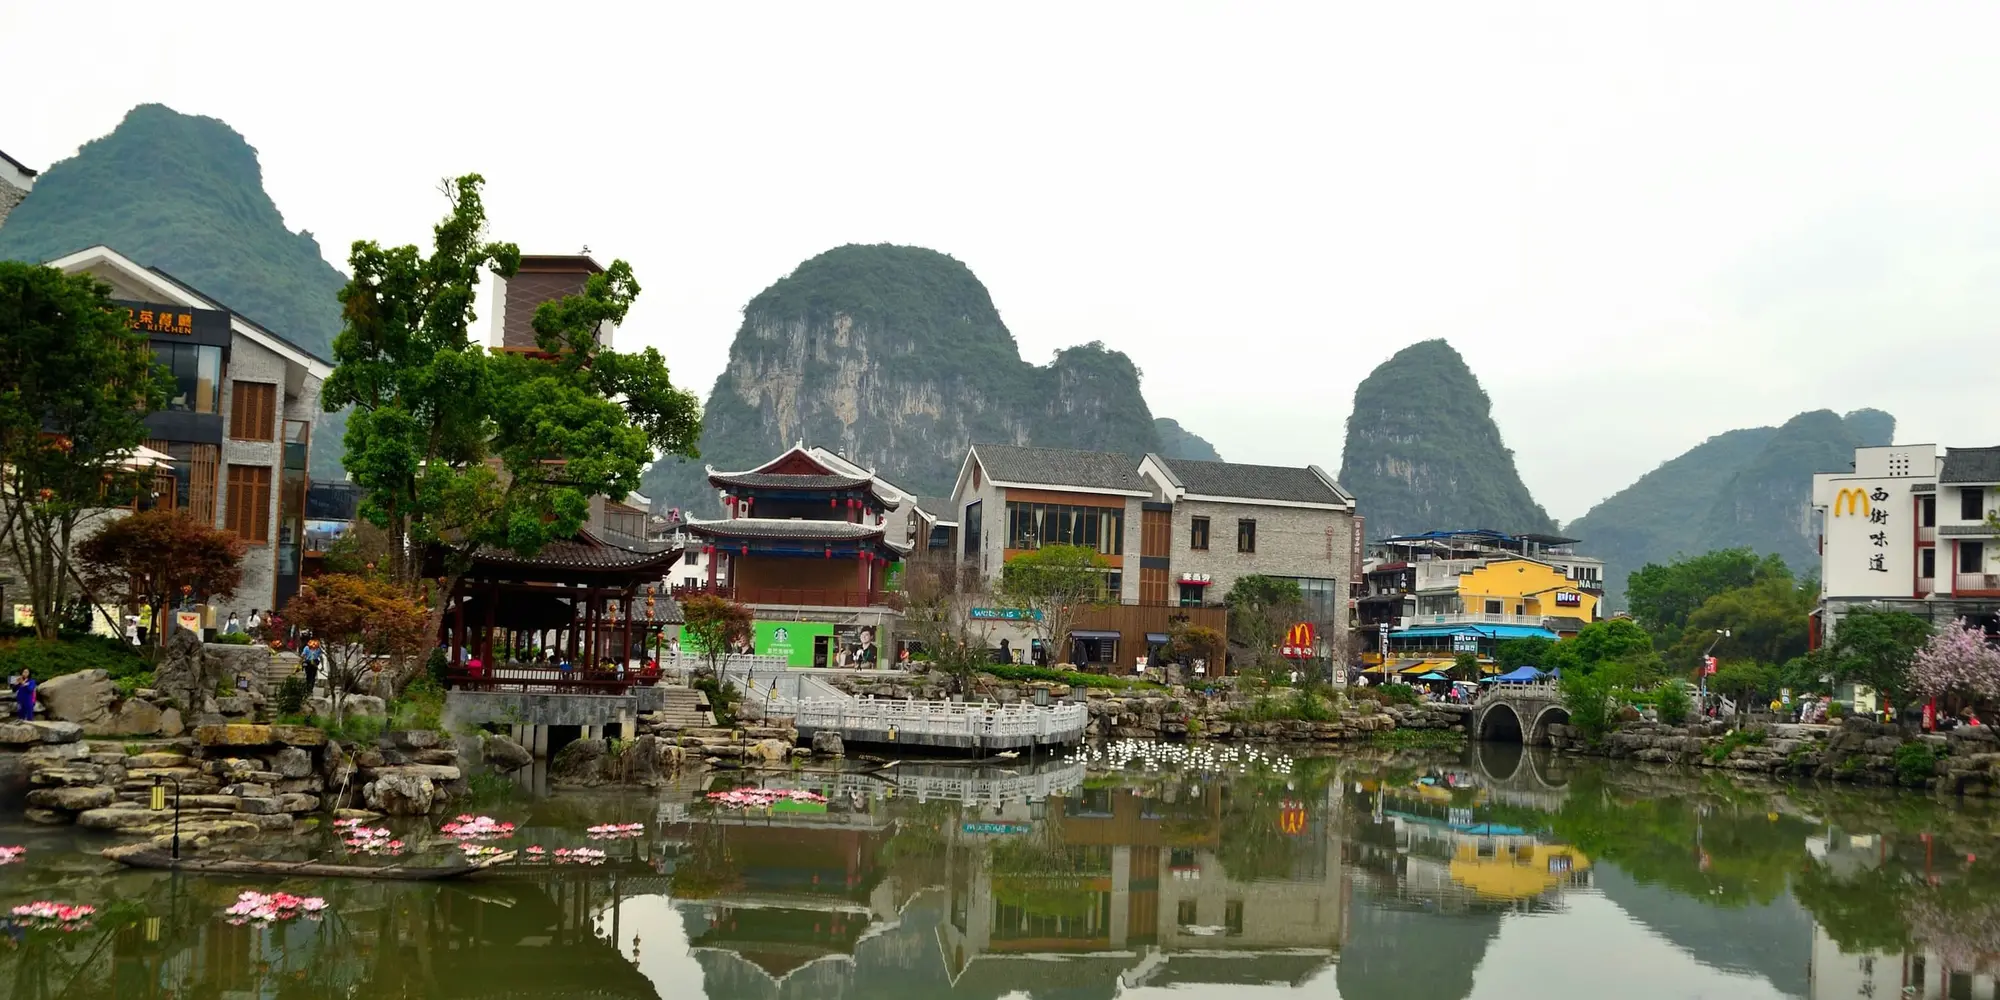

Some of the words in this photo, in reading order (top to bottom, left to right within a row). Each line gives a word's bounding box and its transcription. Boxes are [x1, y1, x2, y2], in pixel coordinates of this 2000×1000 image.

[105, 307, 192, 326] 茶餐廳
[147, 323, 192, 334] KITCHEN
[1869, 487, 1889, 573] 西街味道
